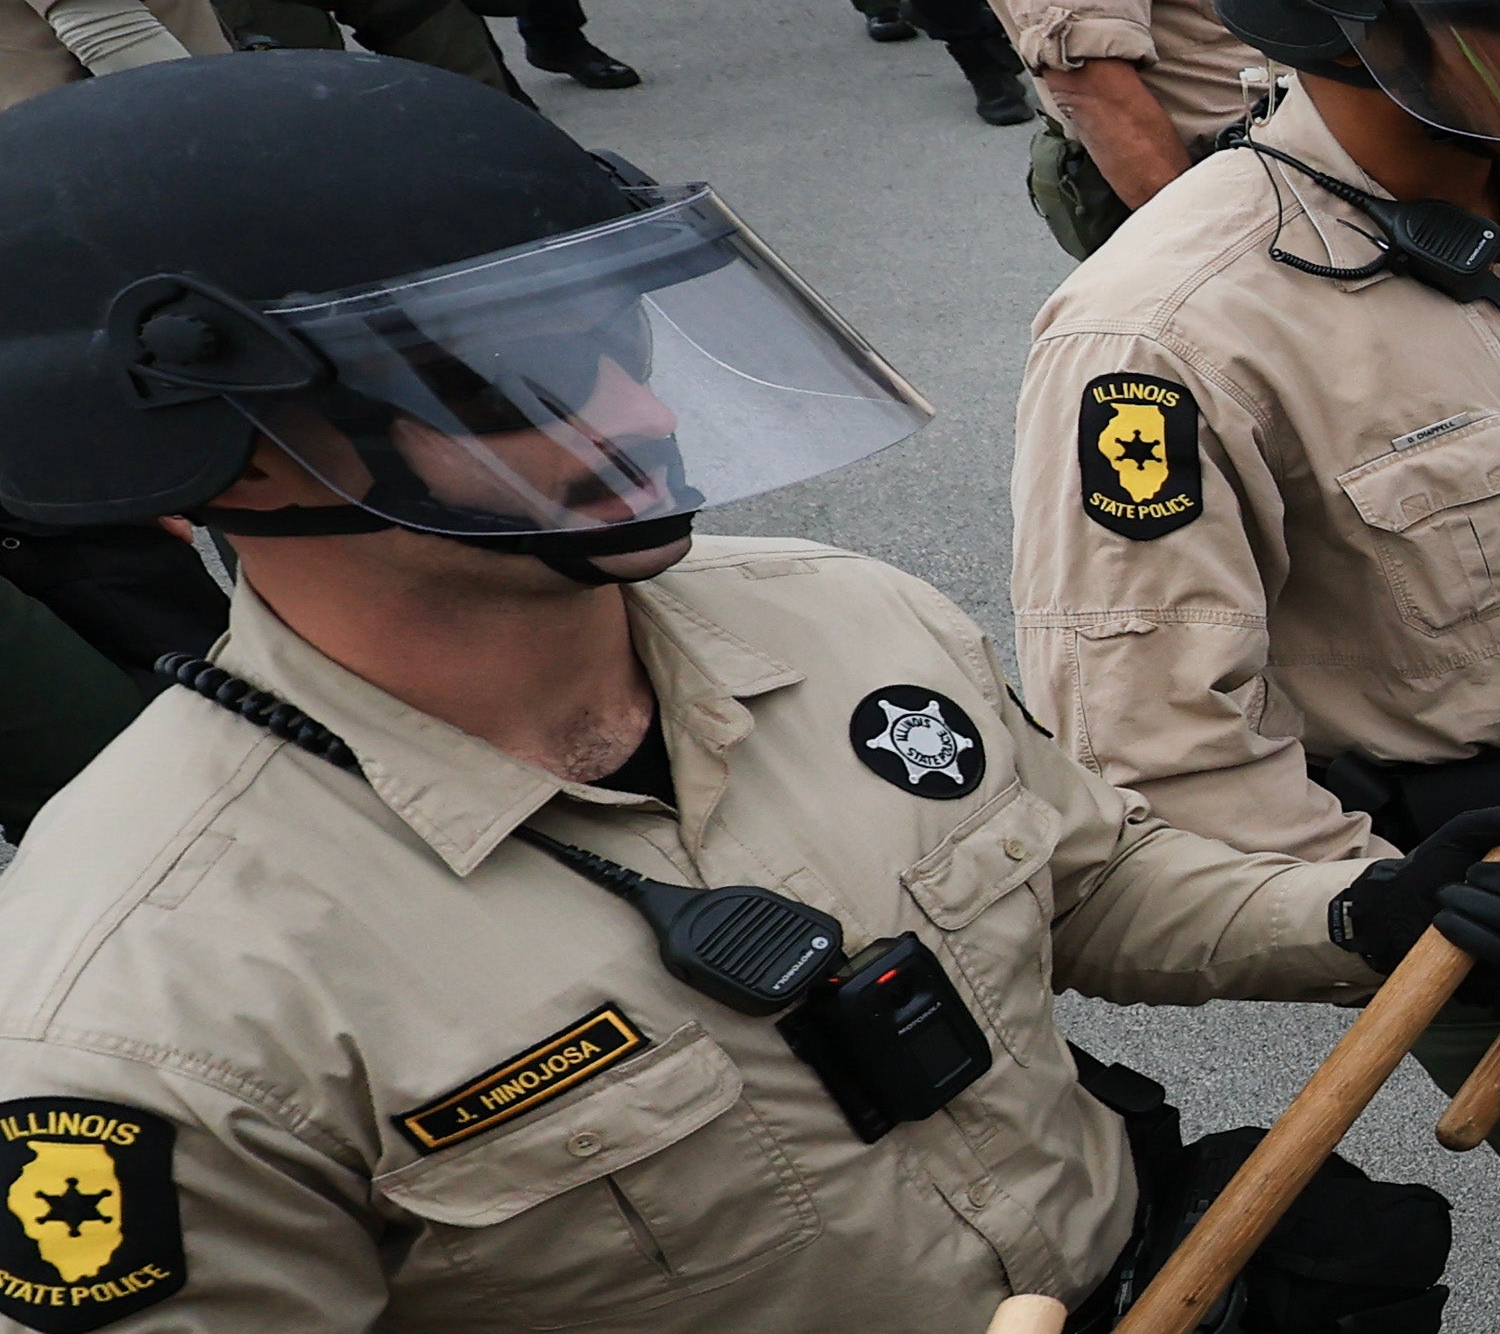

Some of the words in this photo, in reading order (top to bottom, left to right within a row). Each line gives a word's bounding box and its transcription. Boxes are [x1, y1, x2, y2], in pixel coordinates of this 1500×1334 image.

[1093, 382, 1180, 408] ILLINOIS
[1089, 492, 1137, 519] STATE
[1137, 494, 1195, 520] POLICE
[897, 717, 931, 742] ILLINOIS
[906, 747, 941, 766] STATE
[772, 949, 815, 991] MOTOROLA
[898, 1001, 942, 1036] MOTOROLA
[456, 1106, 478, 1123] J.
[480, 1039, 602, 1111] HINOJOSA
[0, 1111, 142, 1146] ILLINOIS
[70, 1263, 171, 1307] POLICE
